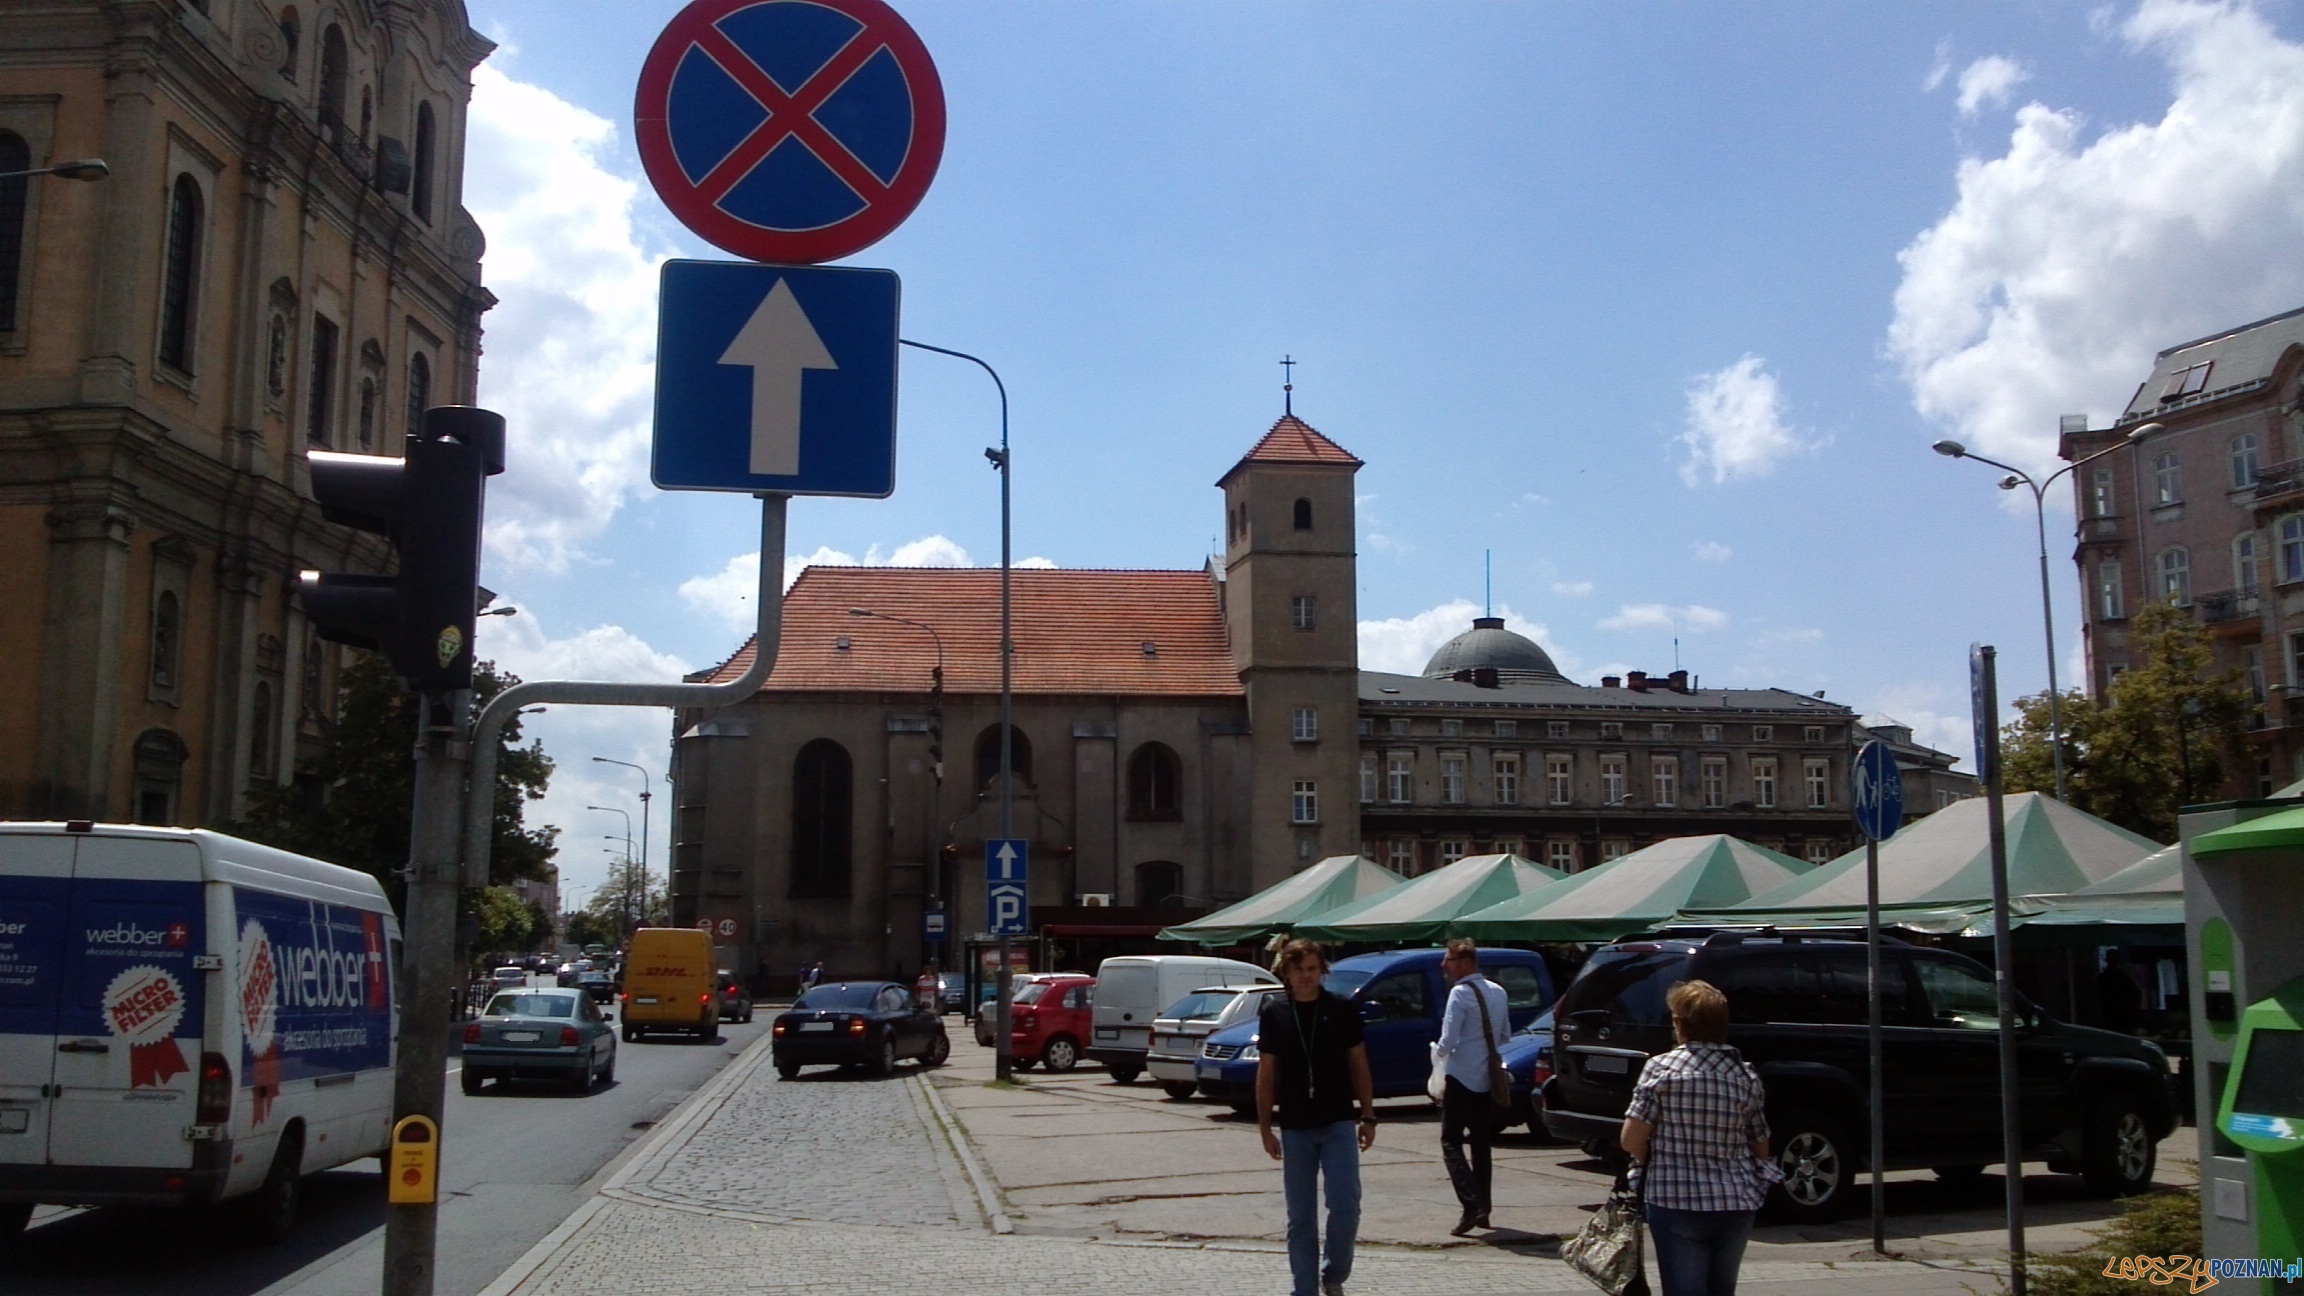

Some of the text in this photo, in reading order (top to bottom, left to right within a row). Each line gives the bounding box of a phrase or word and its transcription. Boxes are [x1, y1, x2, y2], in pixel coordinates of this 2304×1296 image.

[721, 919, 736, 932] 40
[996, 895, 1019, 928] P
[86, 922, 167, 944] webber
[126, 948, 139, 957] do
[276, 898, 366, 1009] webber
[644, 966, 688, 977] DHL
[111, 977, 169, 1021] MICRO
[117, 989, 180, 1034] FILTER
[322, 1021, 333, 1049] do
